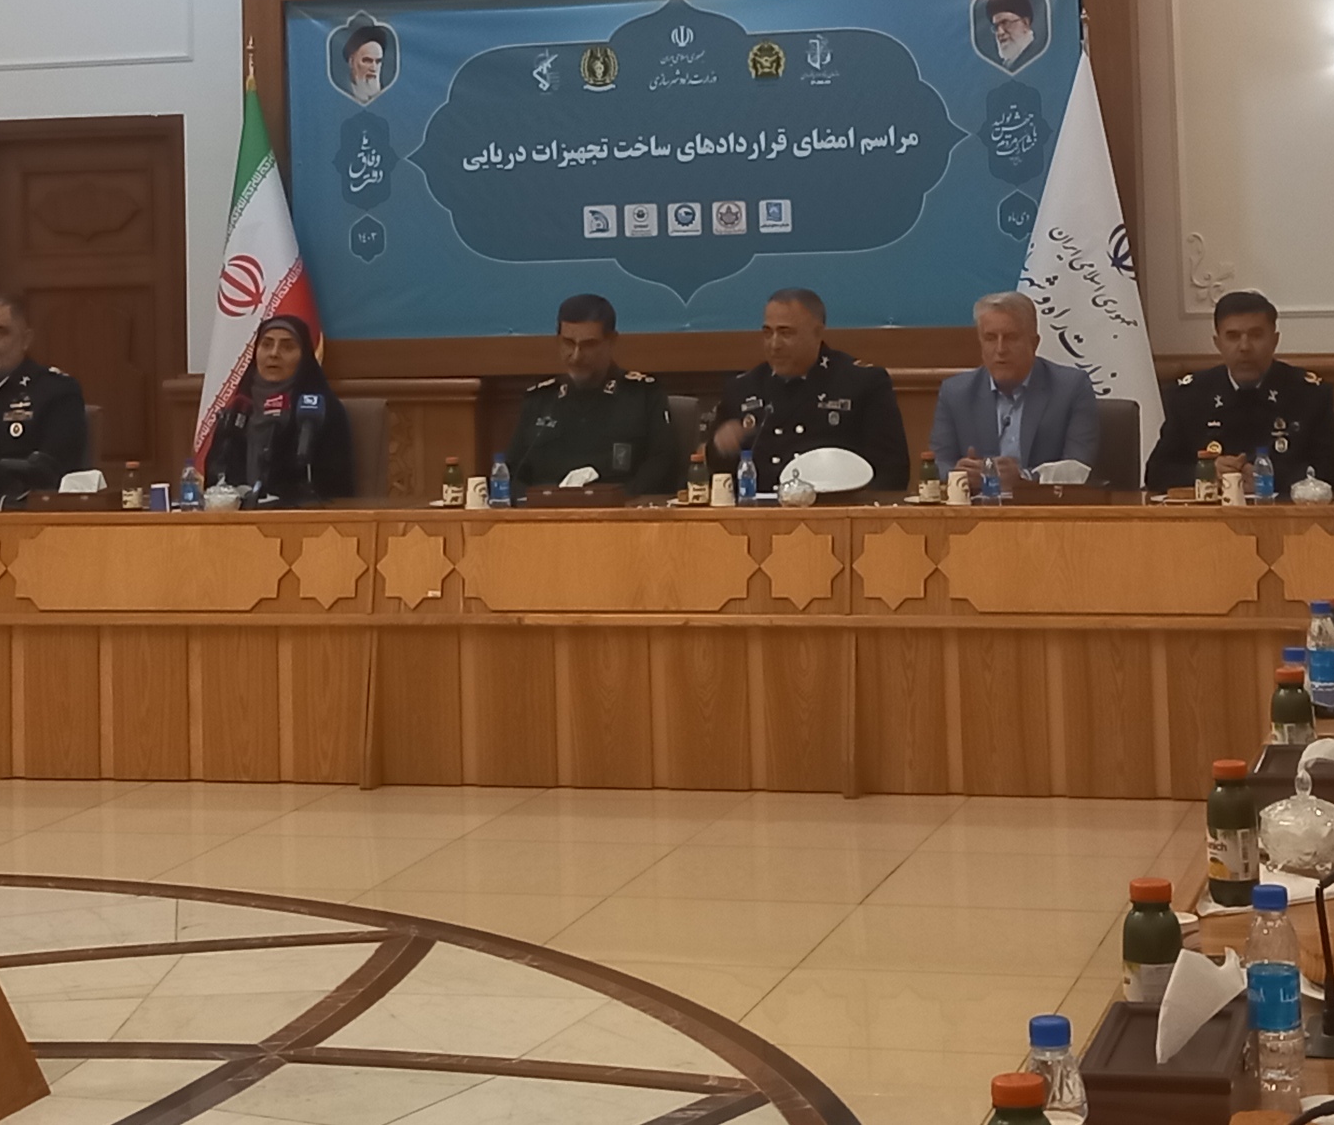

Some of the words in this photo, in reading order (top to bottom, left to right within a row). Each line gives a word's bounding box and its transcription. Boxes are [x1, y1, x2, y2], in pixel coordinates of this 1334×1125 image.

[462, 141, 527, 171] دریایی
[531, 137, 609, 168] تجهیزات
[613, 134, 671, 159] ساخت
[676, 128, 789, 163] قراردادهای
[792, 126, 855, 158] امضای
[860, 124, 919, 156] مراسم
[1048, 226, 1083, 262] ایران
[1068, 256, 1106, 293] اسلامی
[1090, 293, 1139, 340] جمهوری
